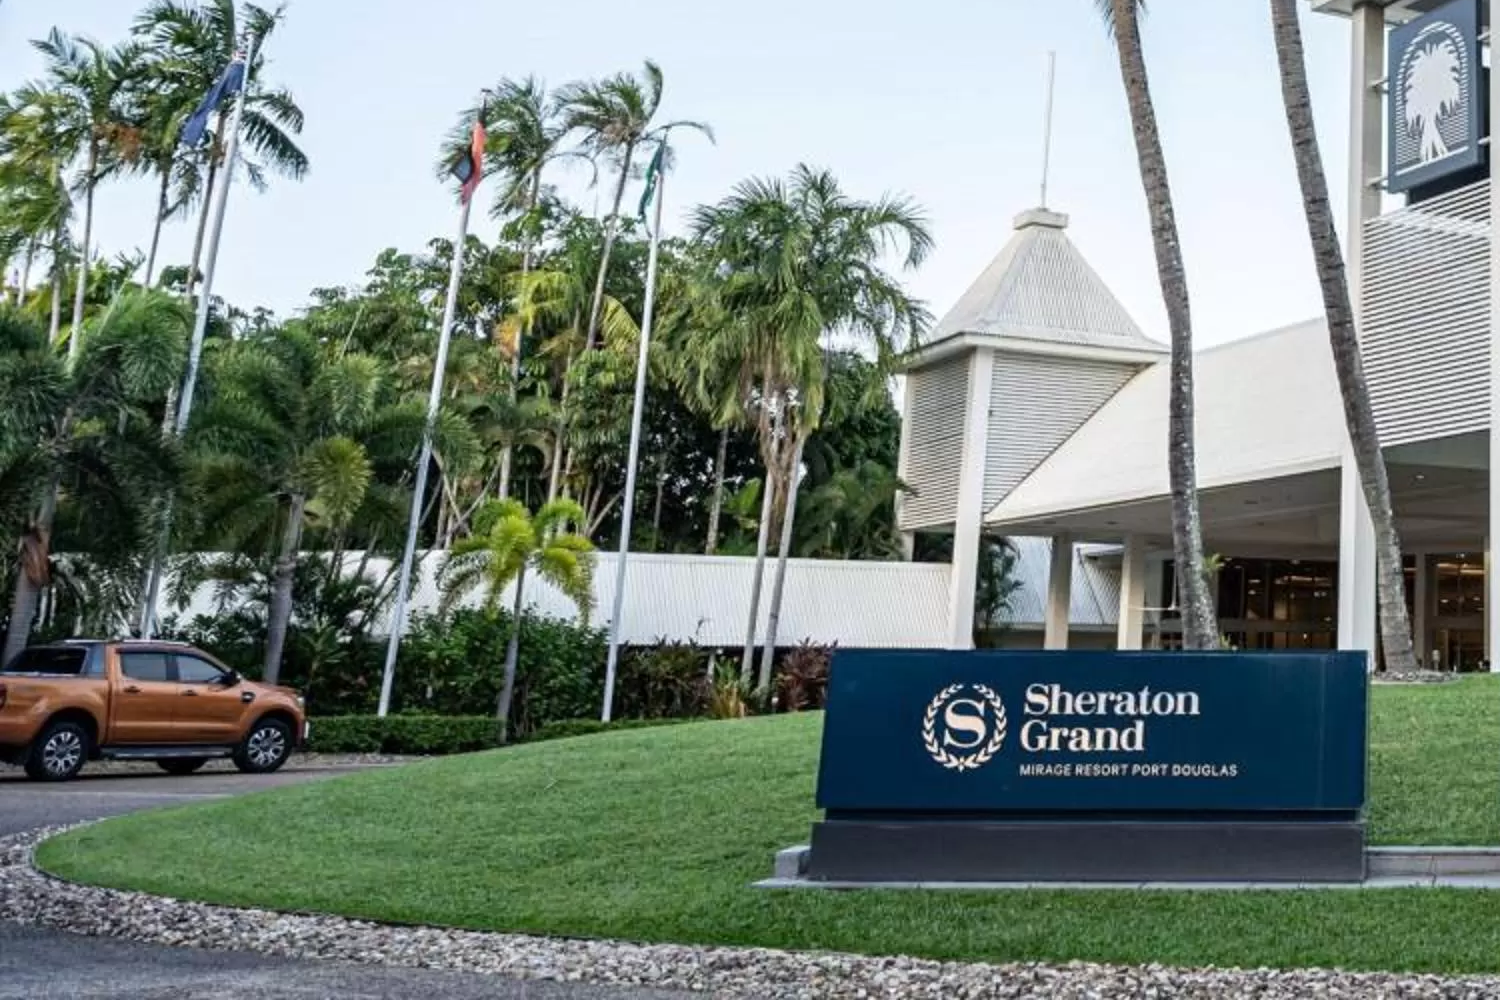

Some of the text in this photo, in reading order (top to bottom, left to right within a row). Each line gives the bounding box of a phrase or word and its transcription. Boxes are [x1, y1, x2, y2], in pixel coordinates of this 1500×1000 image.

[1023, 683, 1201, 717] Sheraton
[943, 699, 987, 748] S
[1020, 719, 1145, 752] Grand
[1019, 763, 1238, 777] MIRAGE RESORT PORT DOUGLAS
